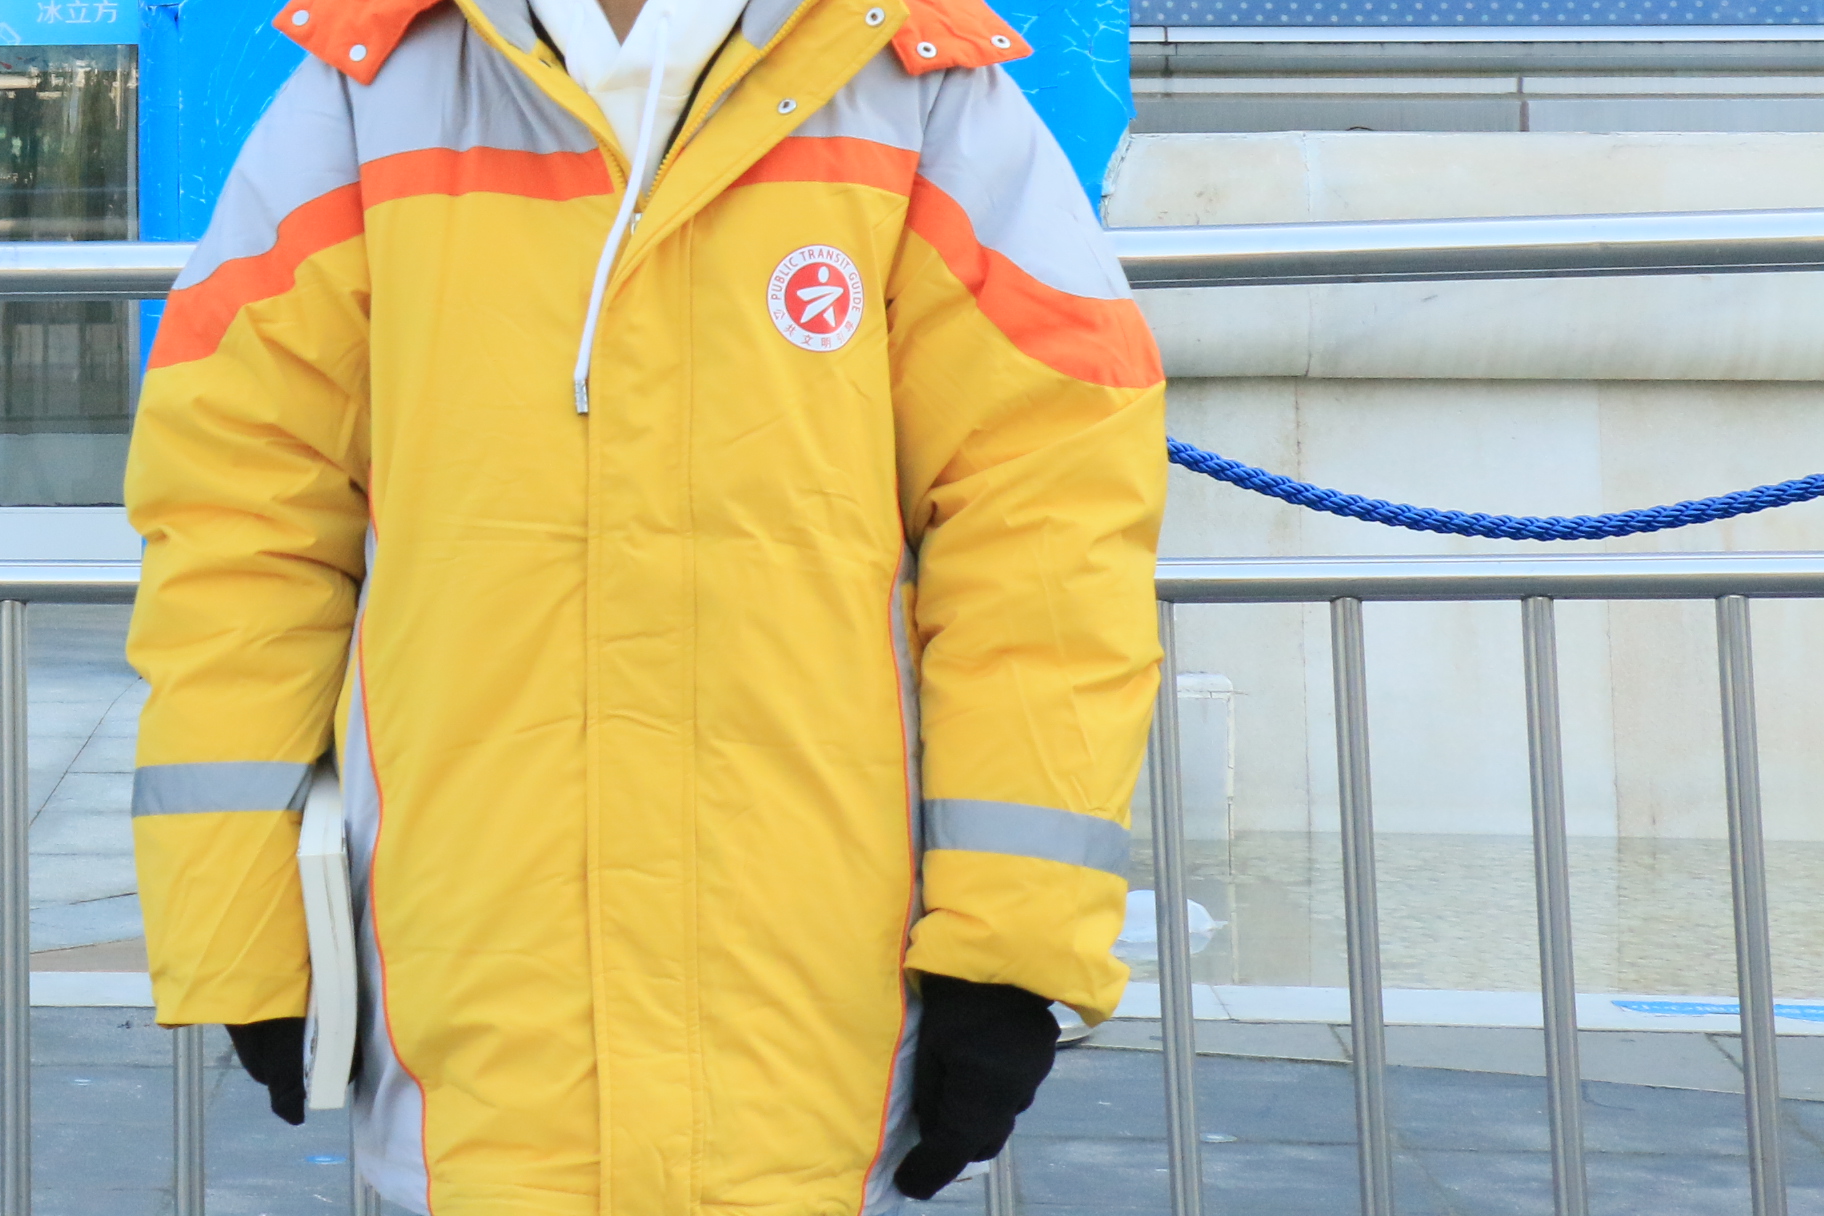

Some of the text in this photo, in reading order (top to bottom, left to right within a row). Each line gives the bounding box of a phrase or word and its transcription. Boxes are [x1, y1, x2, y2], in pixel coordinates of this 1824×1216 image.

[37, 0, 118, 24] 冰立方
[770, 248, 862, 313] PUBLIC TRANSIT GUIDE
